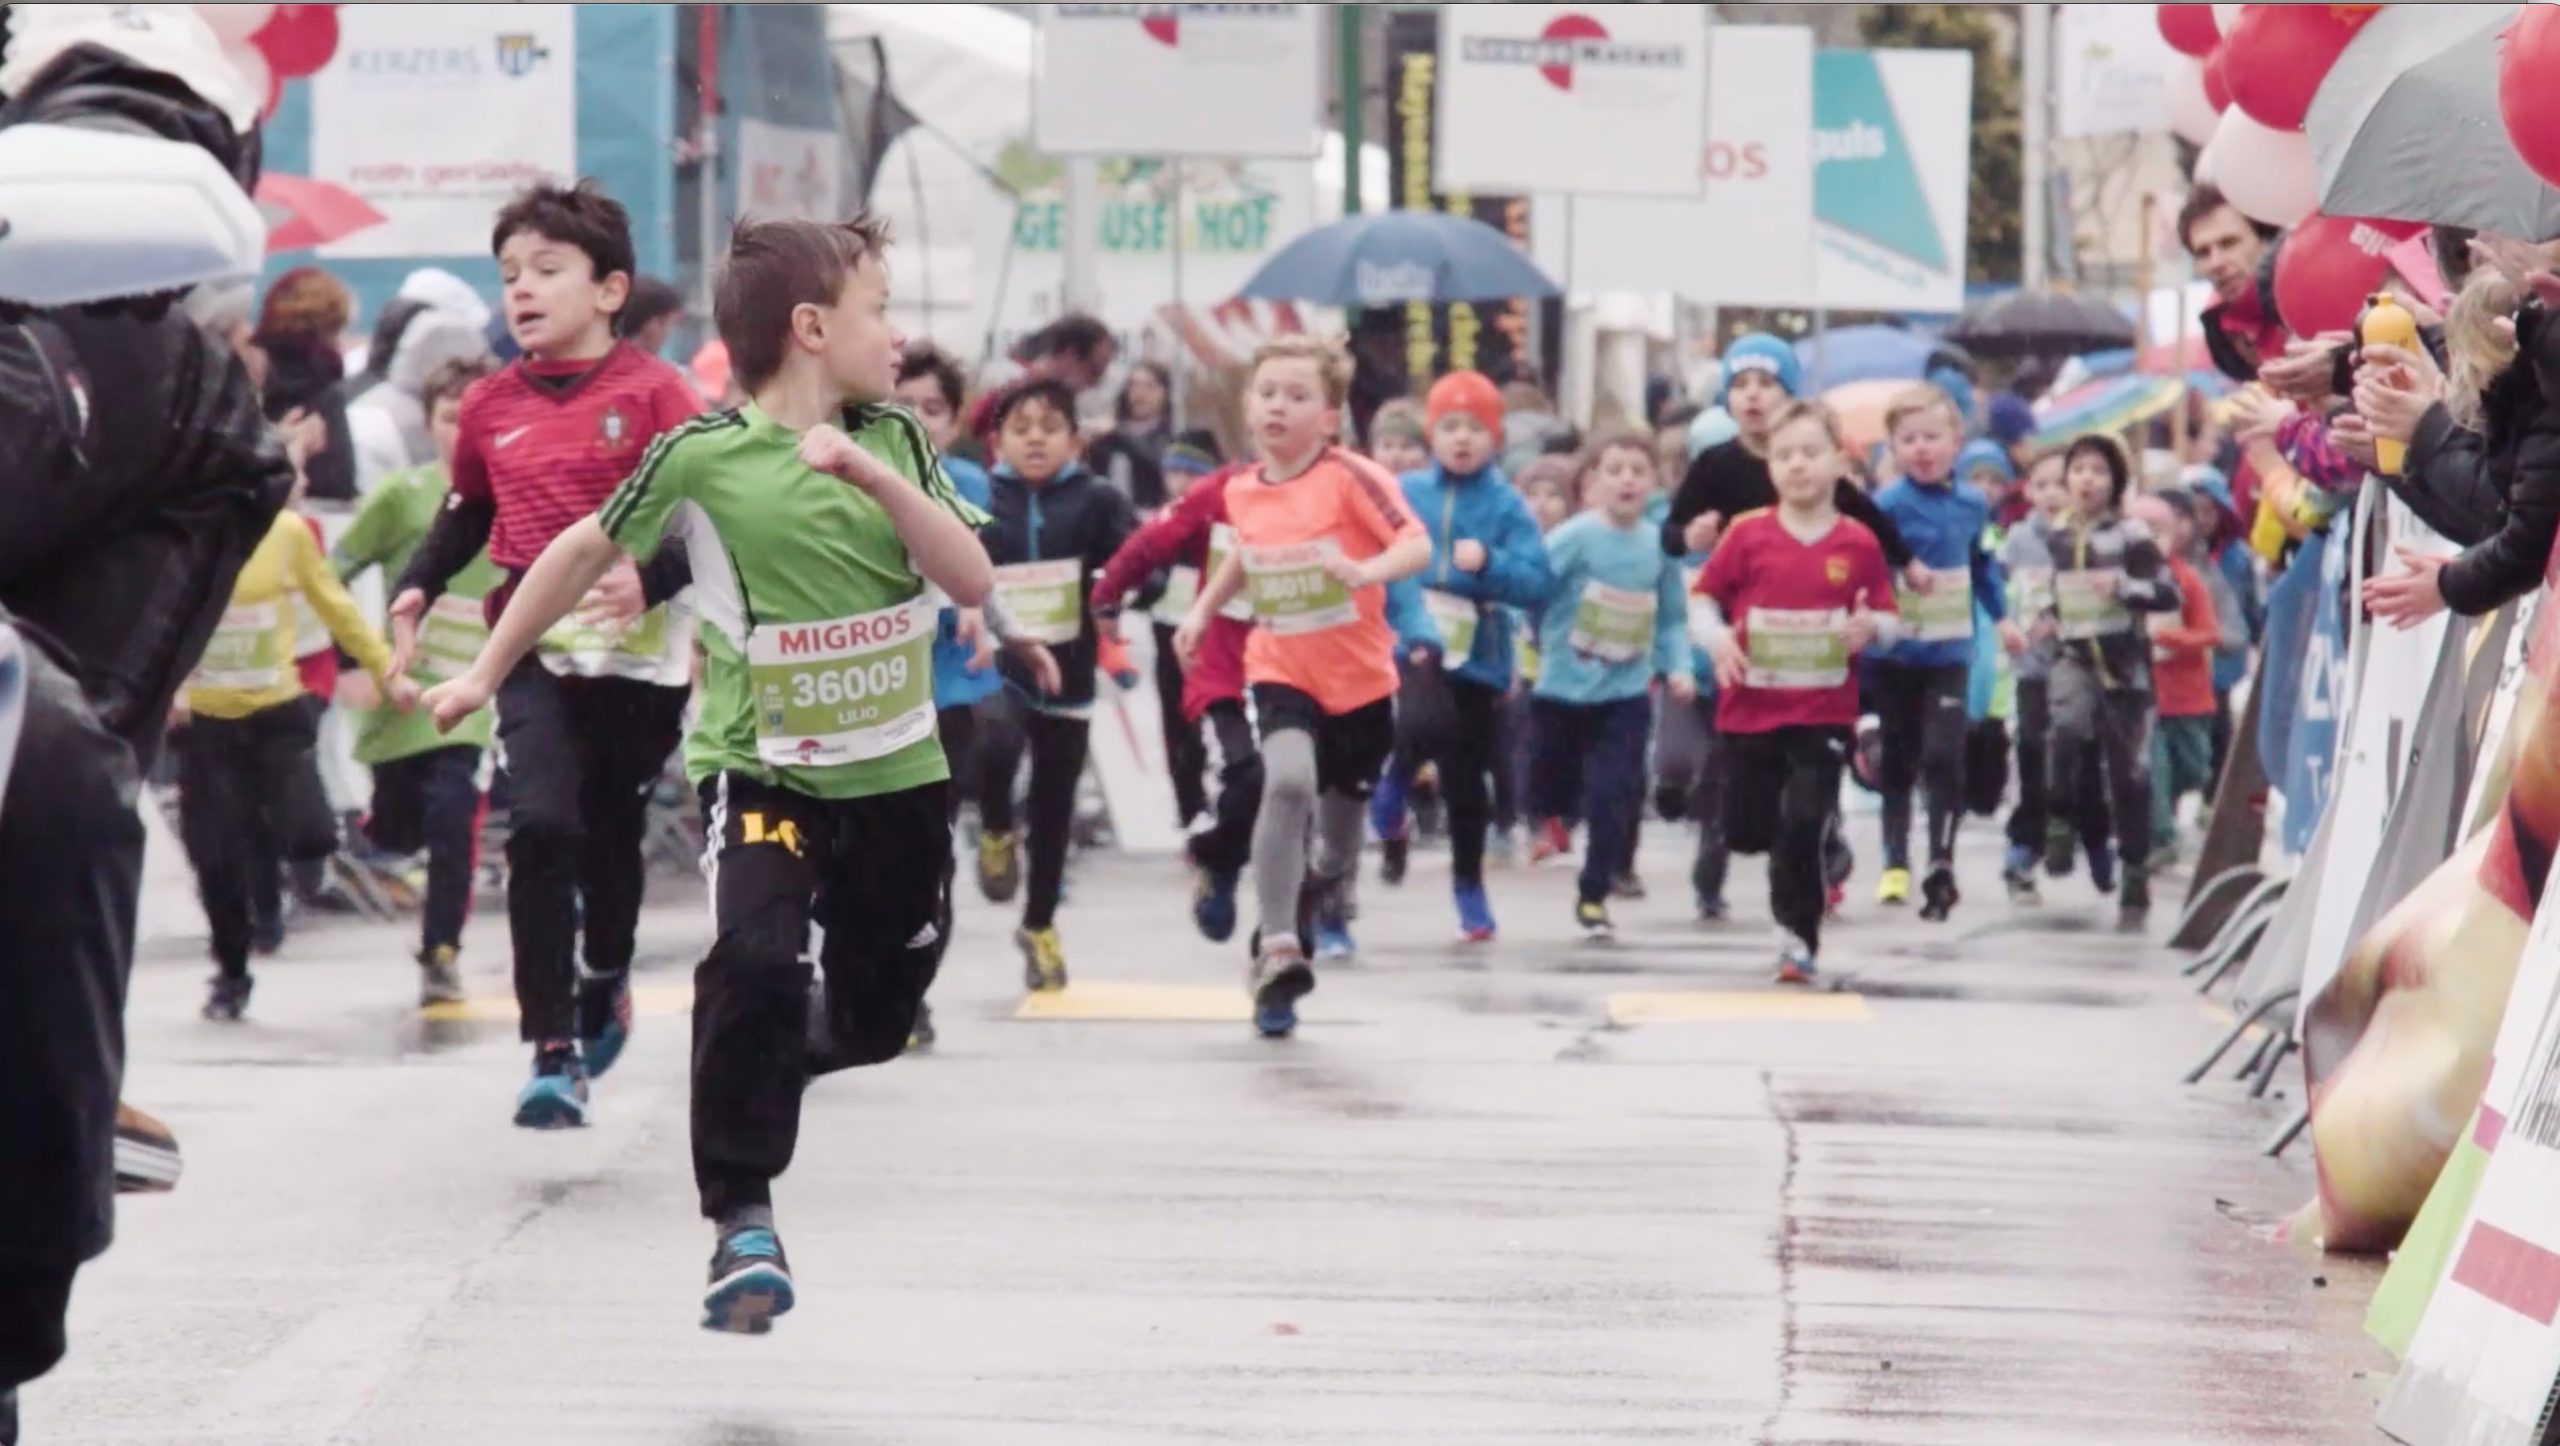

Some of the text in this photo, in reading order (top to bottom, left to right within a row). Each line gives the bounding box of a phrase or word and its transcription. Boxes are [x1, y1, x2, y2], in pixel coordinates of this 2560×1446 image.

[778, 608, 911, 655] MIGROS
[791, 654, 908, 707] 36009
[837, 705, 879, 725] LILIO
